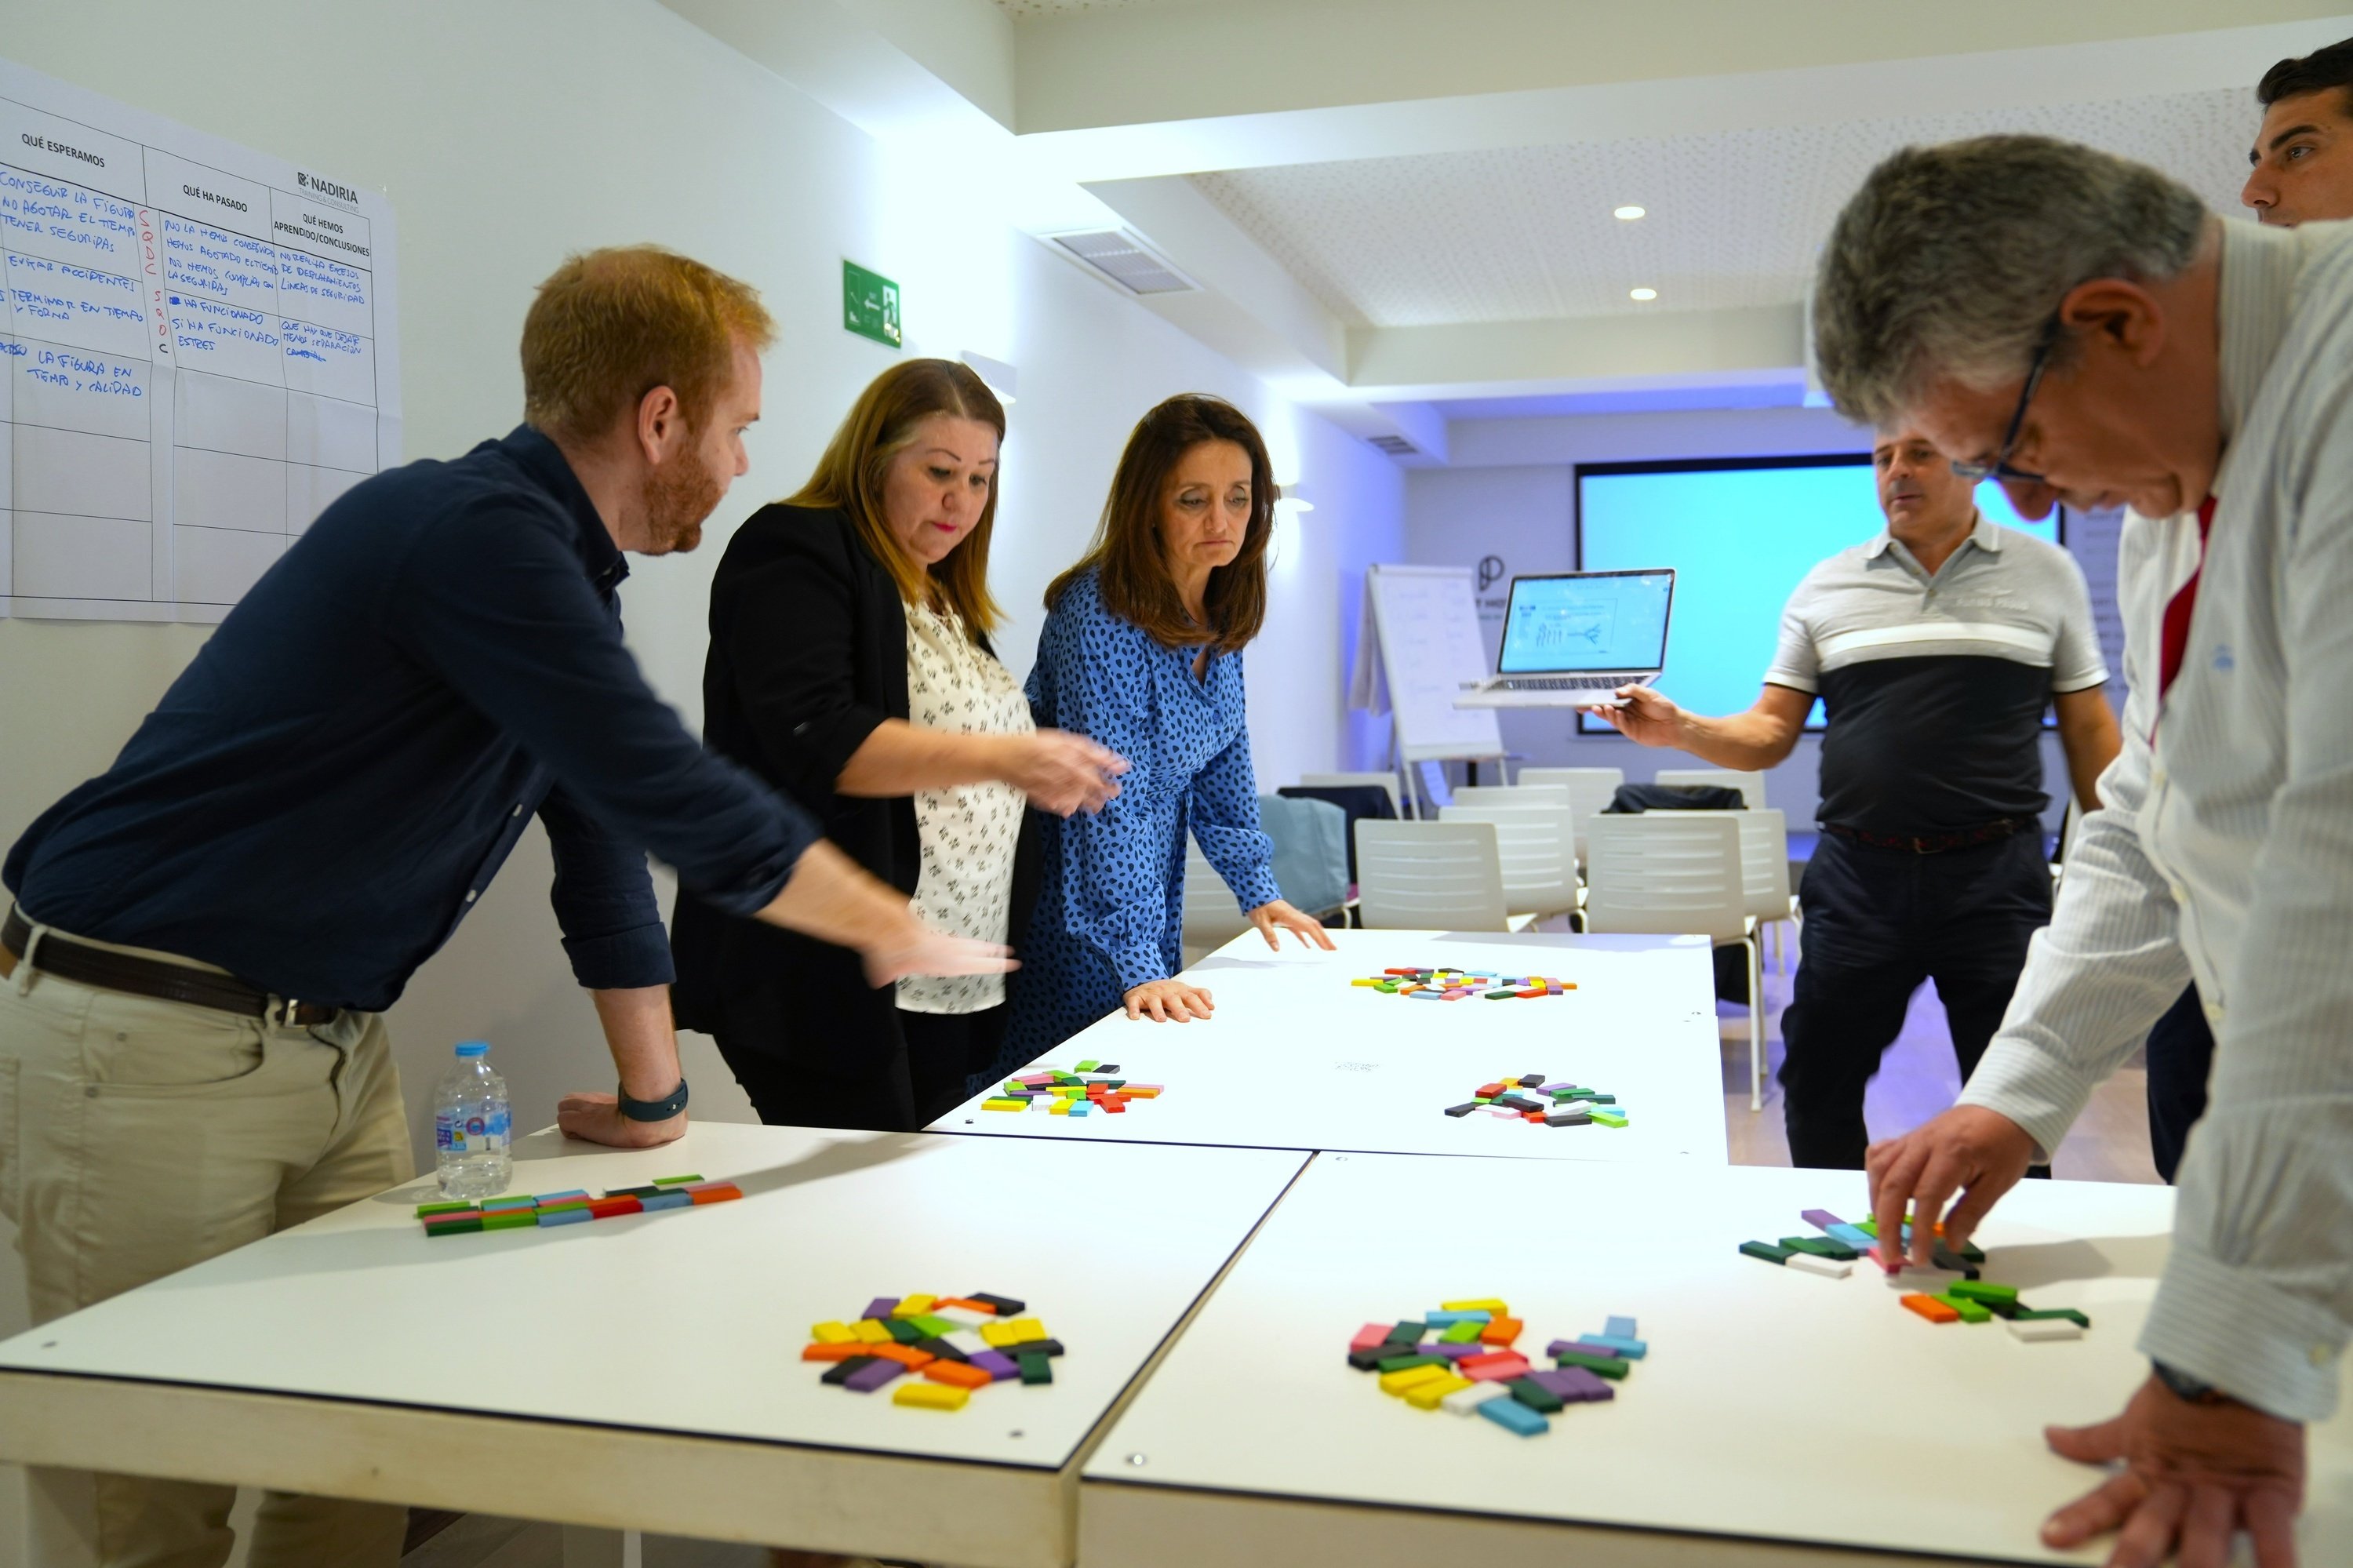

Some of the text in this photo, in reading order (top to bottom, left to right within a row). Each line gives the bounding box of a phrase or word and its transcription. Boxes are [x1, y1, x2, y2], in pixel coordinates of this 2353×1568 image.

[22, 133, 105, 167] QUÉ ESPERAMOS
[75, 191, 87, 204] LA
[183, 184, 248, 213] QUÉ HA PASADO
[299, 187, 322, 202] TRAINING
[327, 197, 359, 213] CONSULTING
[311, 176, 358, 204] NADIRIA
[2, 197, 17, 210] NO
[23, 199, 72, 220] AGOTAR
[78, 213, 96, 224] EL
[1, 213, 43, 233] TENER
[165, 220, 180, 232] NO
[184, 224, 195, 235] LA
[303, 213, 344, 234] QUÉ HEMOS
[274, 221, 369, 256] APRENDIDO/CONCLUSIONES
[169, 257, 182, 268] NO
[200, 246, 241, 264] AGOTADO
[281, 264, 293, 274] DE
[80, 301, 100, 313] EN
[38, 351, 54, 364] LA
[114, 367, 132, 377] EN
